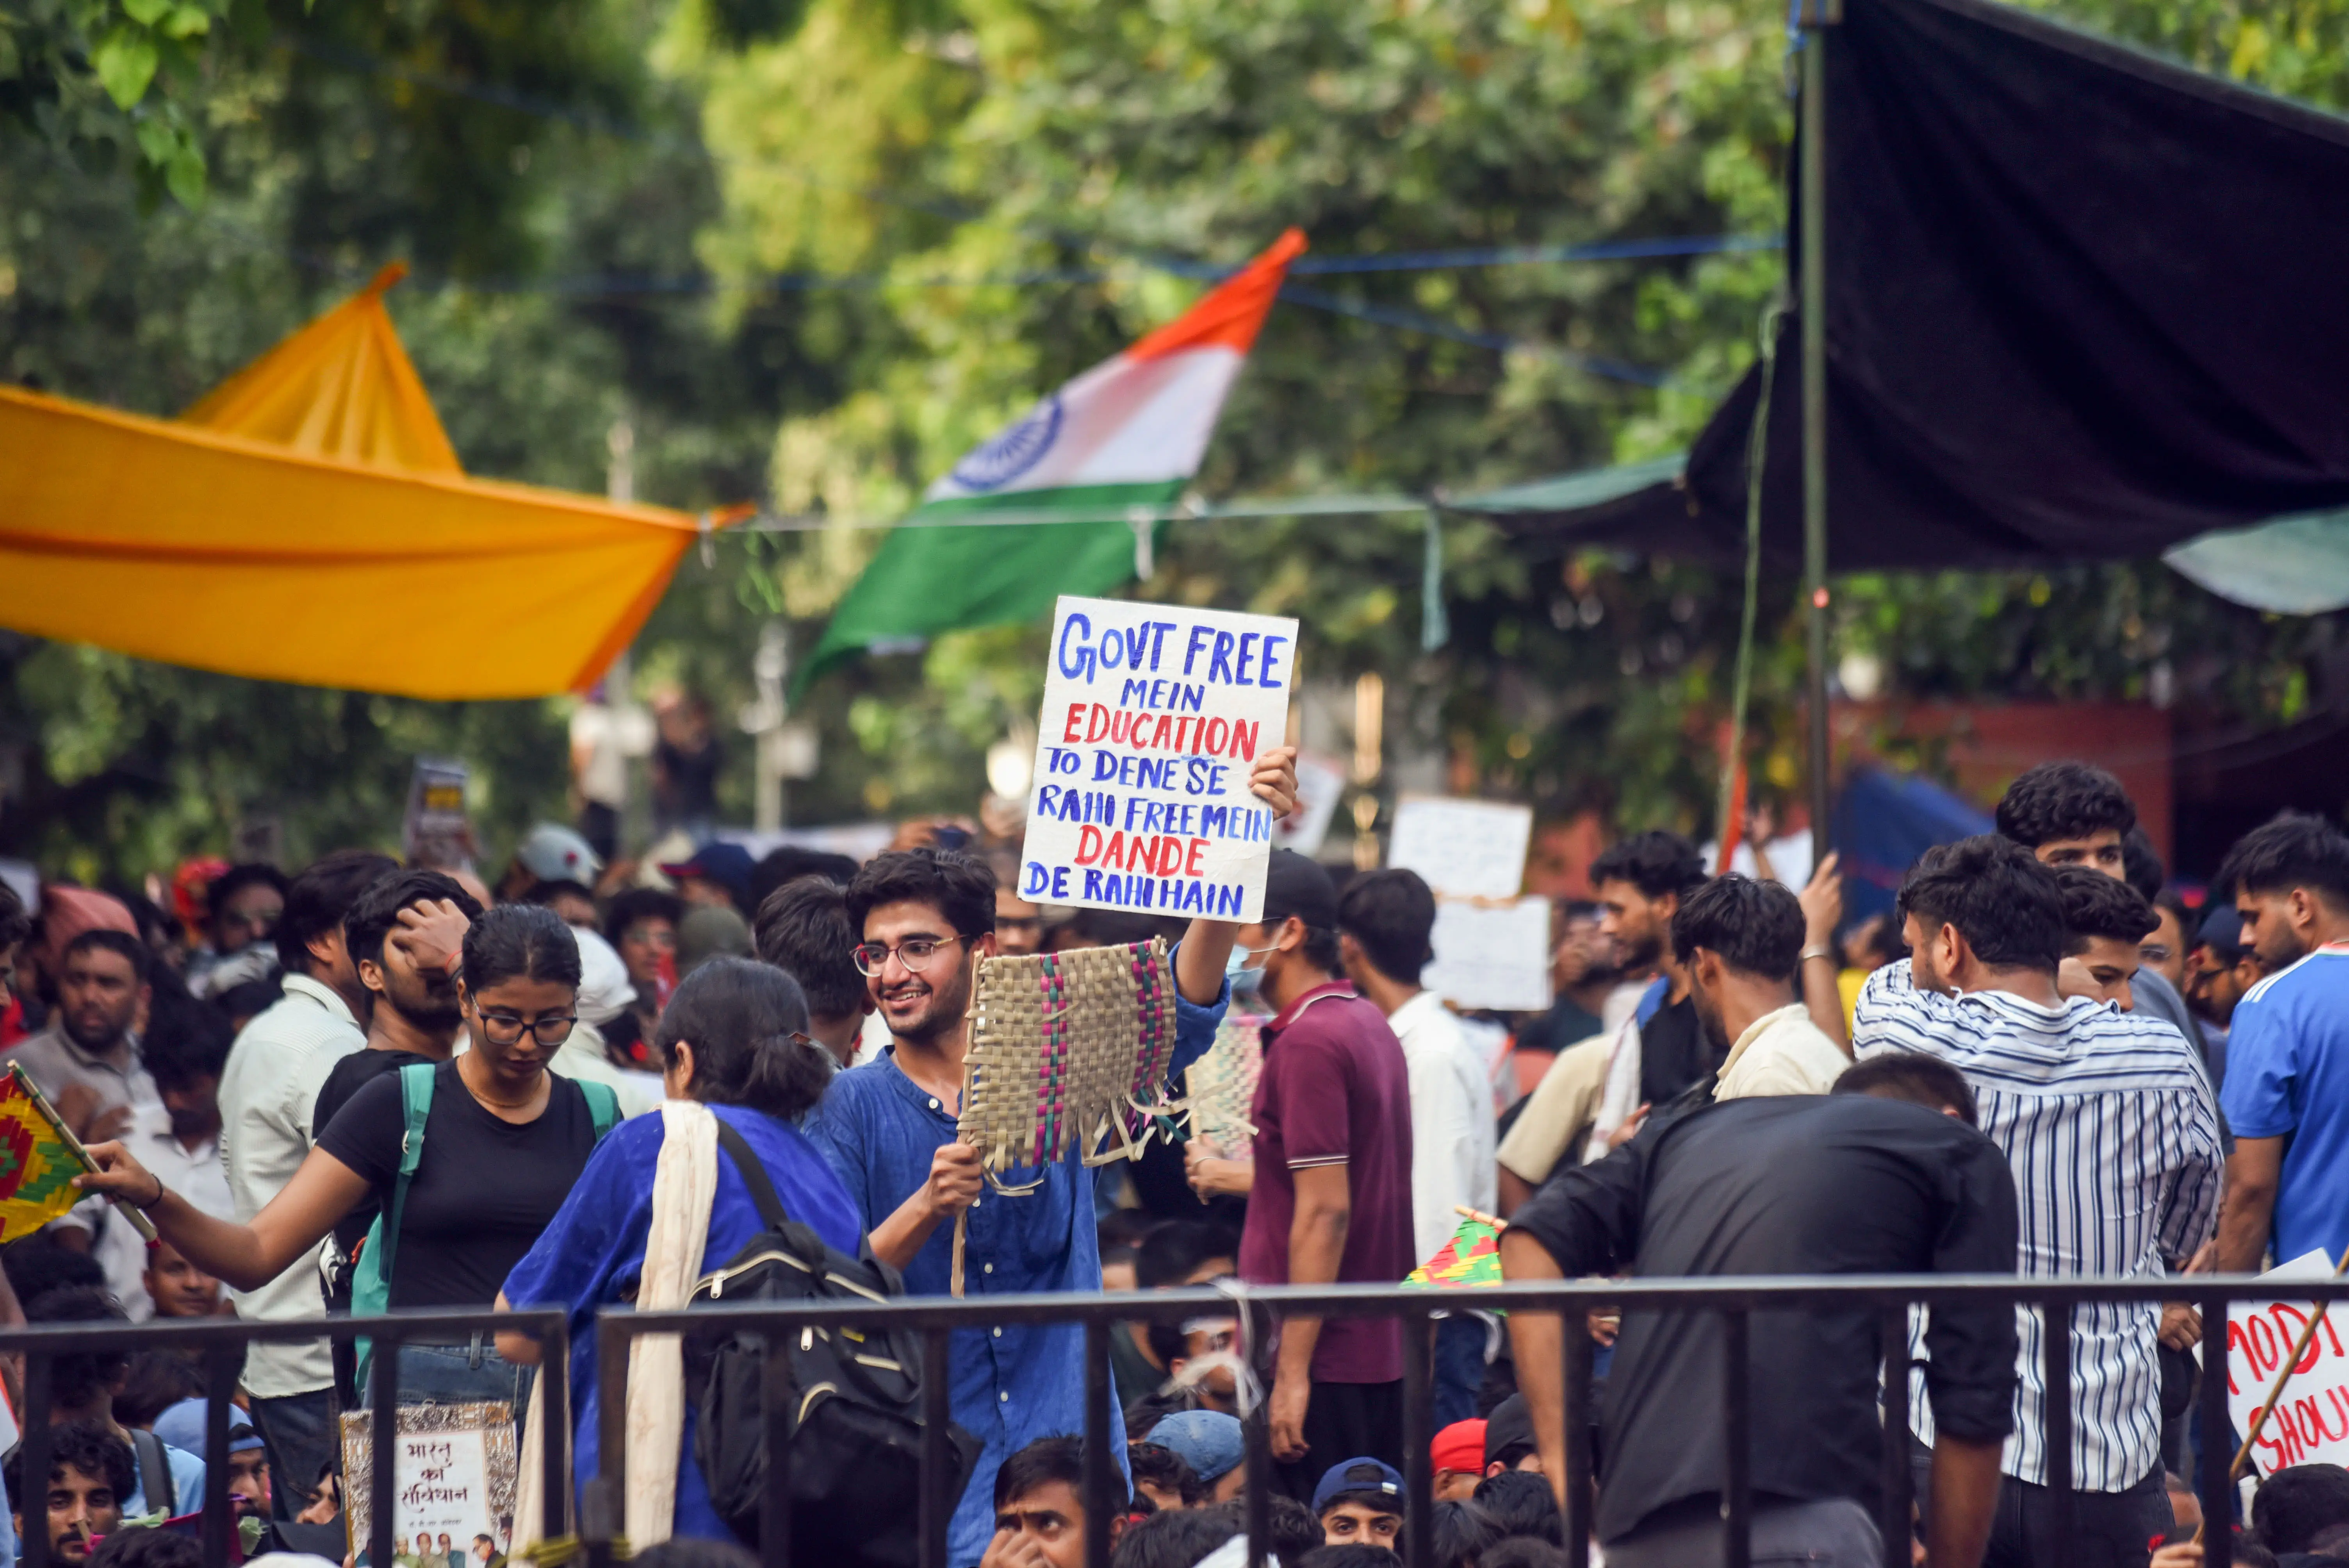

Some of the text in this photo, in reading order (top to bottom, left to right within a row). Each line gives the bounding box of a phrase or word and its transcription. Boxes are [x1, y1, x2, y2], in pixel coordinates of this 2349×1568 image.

[1059, 613, 1288, 688] GOVT FREE
[1119, 678, 1205, 712] MEIN
[1063, 702, 1259, 763] EDUCATION
[1043, 747, 1230, 796] TO DENE SE
[1037, 784, 1116, 827] RAHI
[1124, 797, 1198, 836] FREE
[1200, 804, 1272, 843] MEIN
[1073, 824, 1211, 878] DANDE
[1023, 861, 1244, 917] DE RAHI HAIN
[407, 1441, 452, 1468] भारत
[2249, 1384, 2349, 1474] SHOU
[397, 1482, 468, 1513] संविधान
[419, 1467, 444, 1483] का
